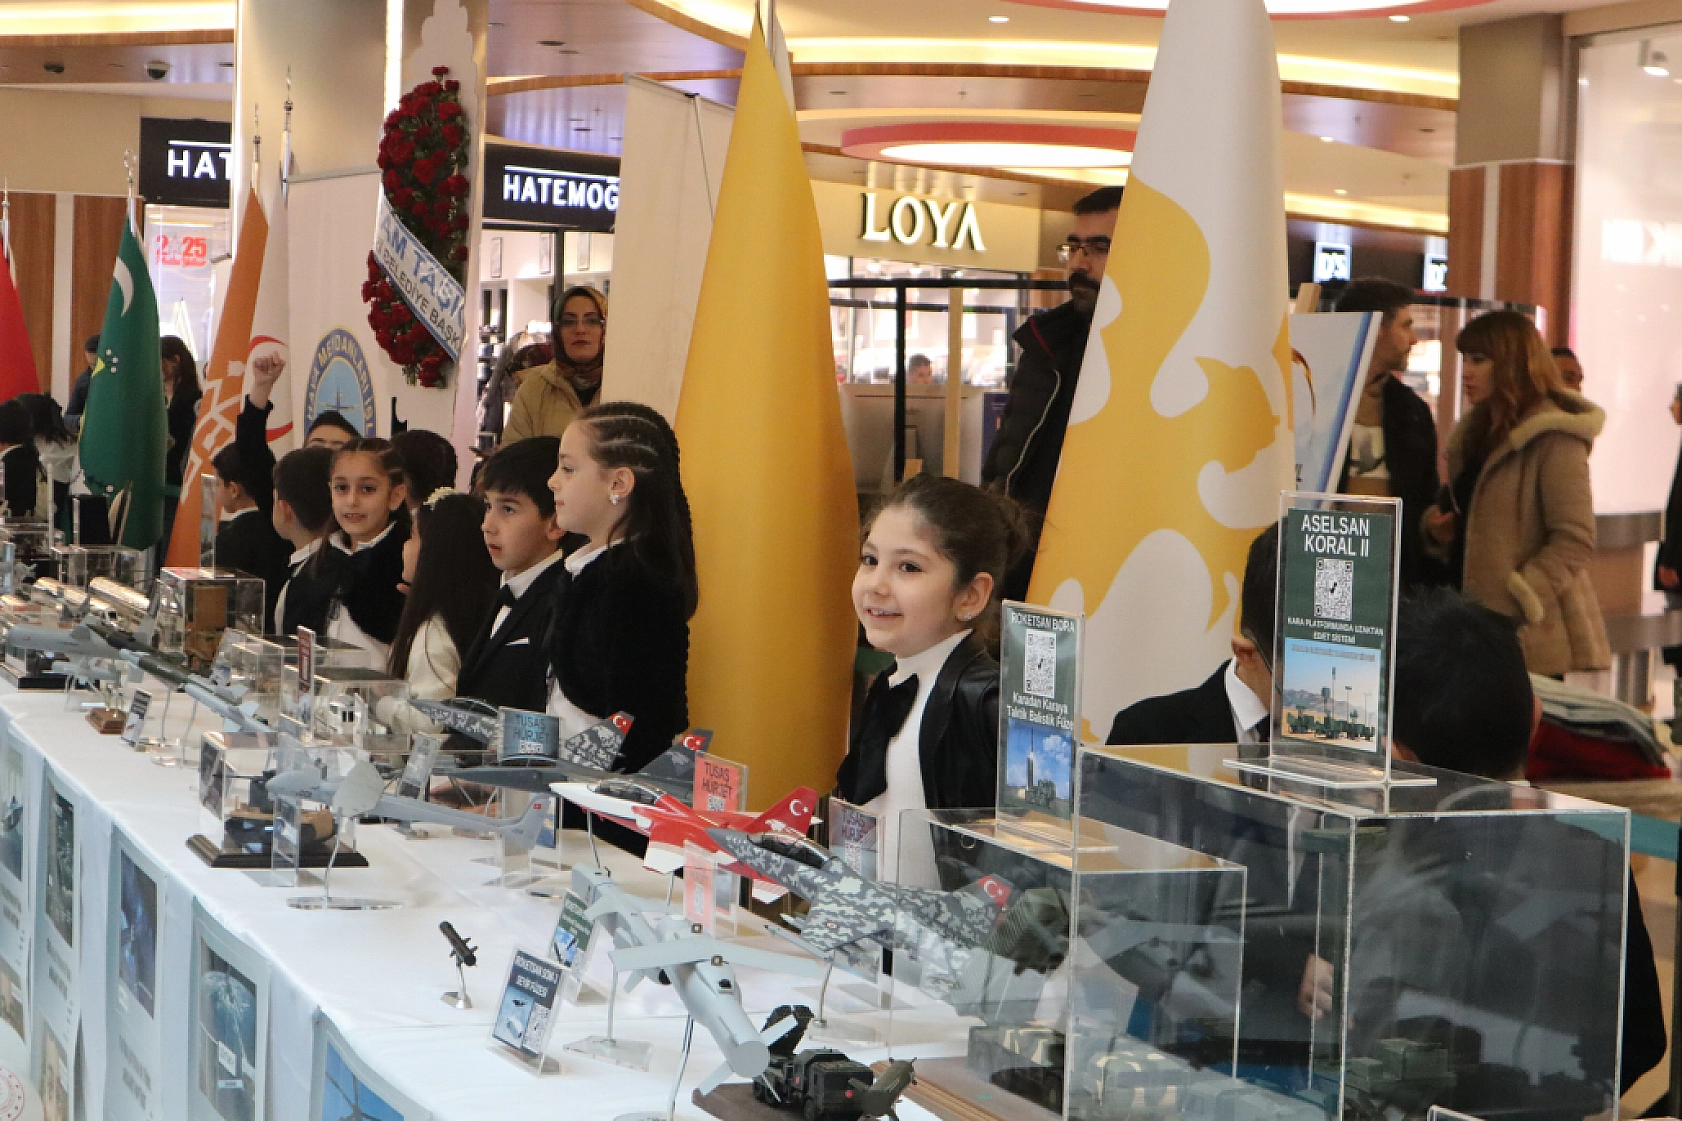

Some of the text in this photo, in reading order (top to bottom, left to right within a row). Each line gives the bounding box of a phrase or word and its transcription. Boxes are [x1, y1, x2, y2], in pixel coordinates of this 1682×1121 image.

[167, 149, 232, 180] HAT
[1301, 514, 1370, 537] ASELSAN
[1304, 534, 1369, 557] KORAL II
[1011, 612, 1052, 629] ROKETSAN
